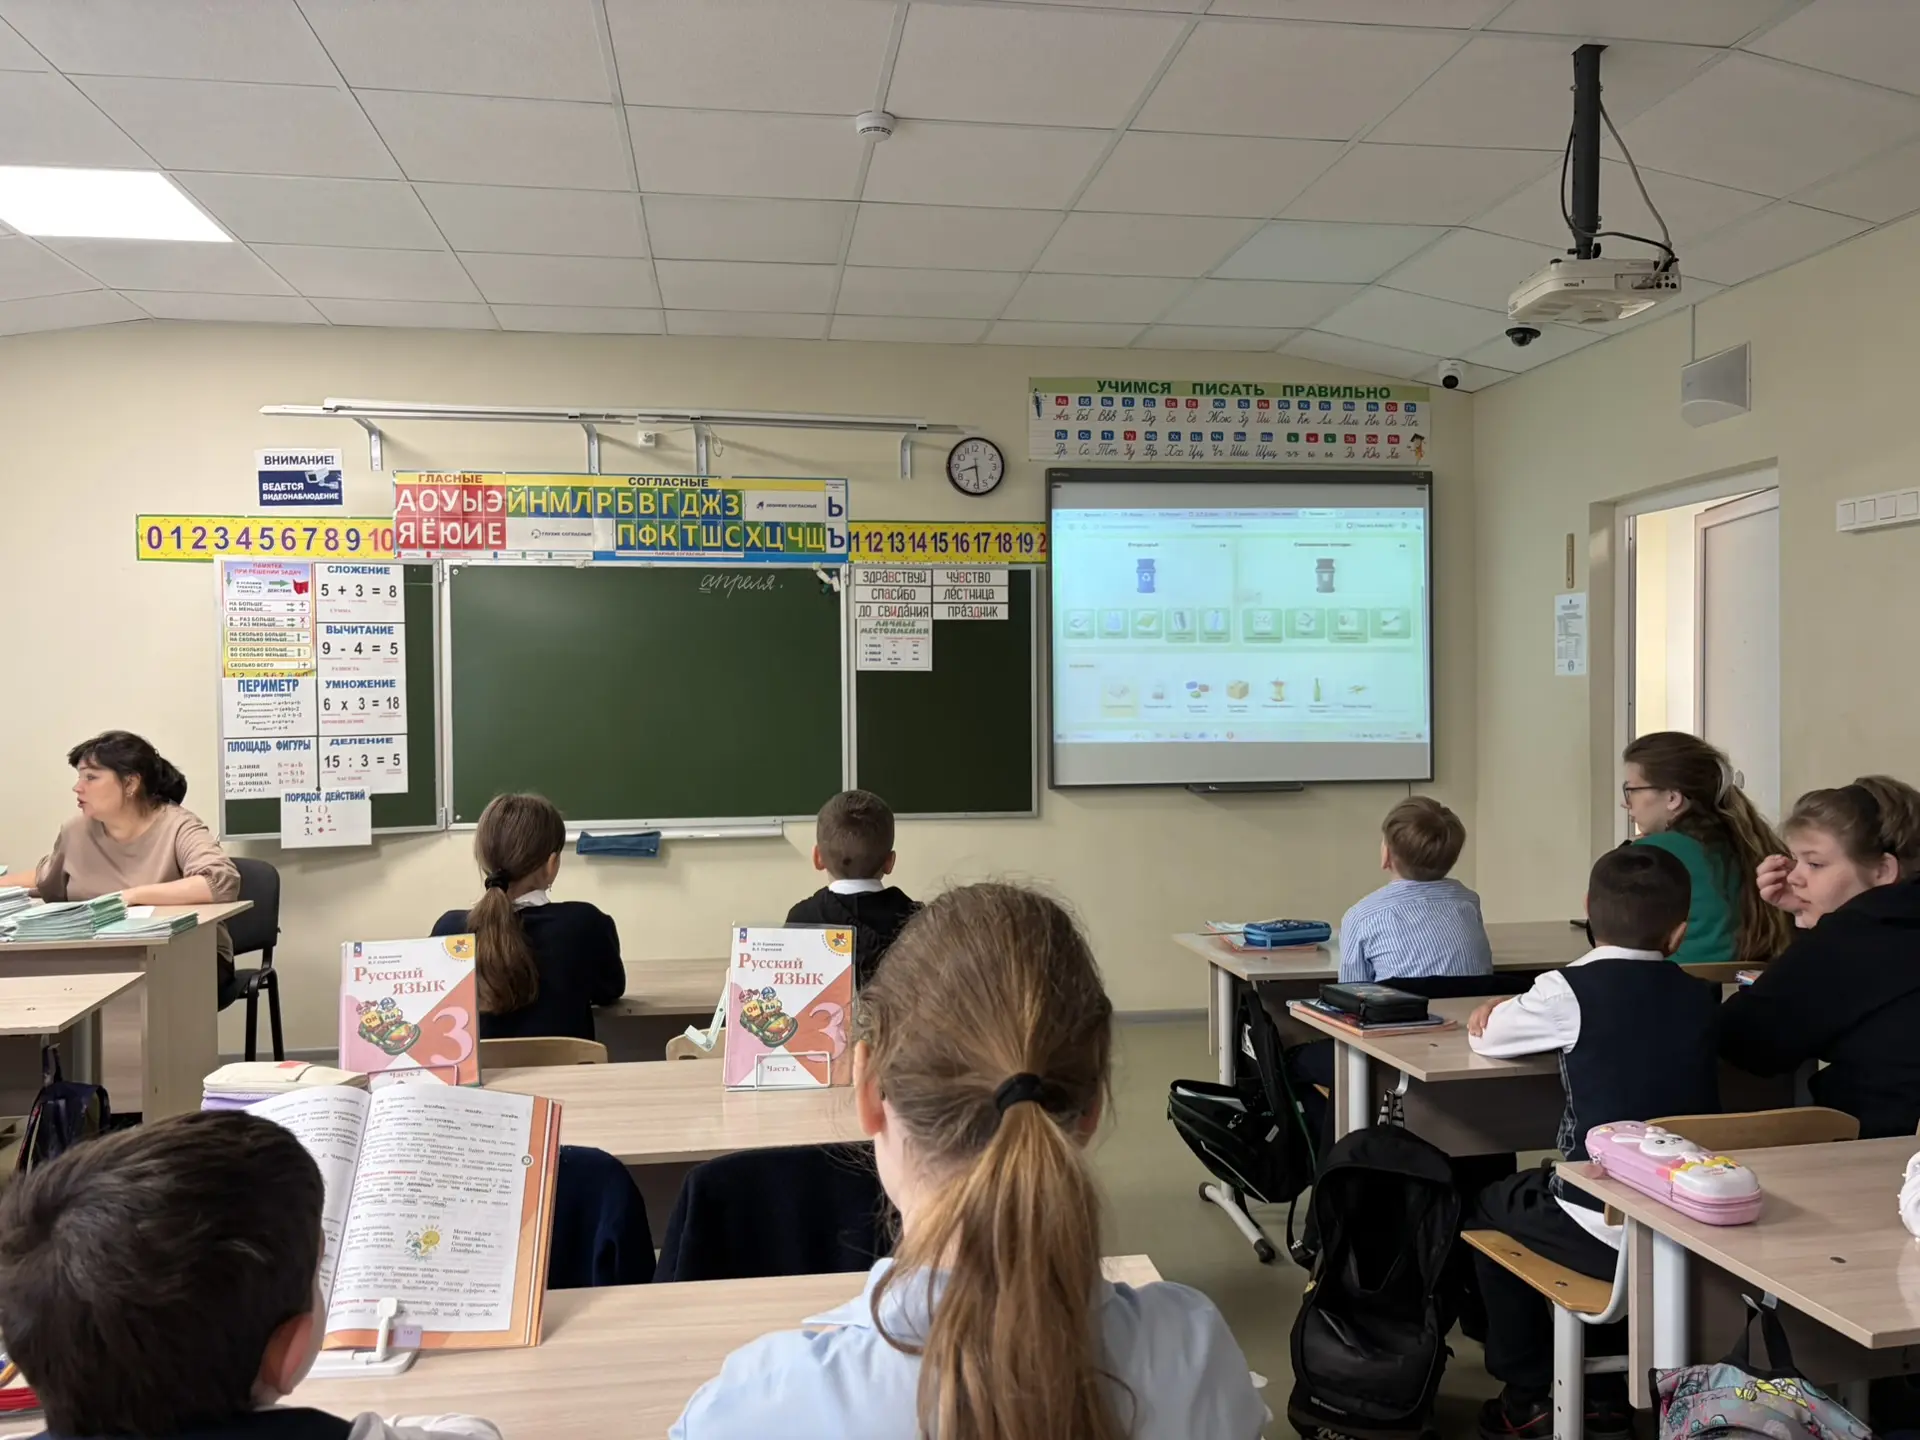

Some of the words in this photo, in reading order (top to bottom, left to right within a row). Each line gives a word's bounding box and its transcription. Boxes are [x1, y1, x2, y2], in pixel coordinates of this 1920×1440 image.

[1097, 380, 1172, 394] УЧИМСЯ
[1192, 383, 1265, 396] ПИСАТЬ
[1283, 384, 1391, 399] ПРАВИЛЬНО
[264, 456, 334, 465] ВНИМАНИЕ!
[418, 474, 483, 484] ГЛАСНЫЕ
[628, 477, 709, 488] СОГЛАСНЫЕ
[262, 483, 304, 491] ВЕДЕТСЯ
[262, 493, 339, 501] ВИДЕОНАБЛЮДЕНИЕ
[147, 526, 162, 549] 0
[171, 526, 181, 549] 1
[192, 526, 207, 549] 2
[214, 526, 229, 550] 3
[236, 527, 252, 549] 4
[260, 528, 274, 550] 5
[282, 528, 296, 550] 6
[302, 528, 317, 550] 7
[325, 528, 339, 551] 8
[346, 528, 360, 551] 9
[368, 528, 393, 551] 10
[865, 532, 883, 552] 12
[888, 532, 905, 553] 13
[909, 532, 927, 553] 14
[931, 532, 948, 553] 15
[952, 532, 970, 553] 16
[974, 532, 991, 553] 17
[995, 532, 1012, 553] 18
[1016, 532, 1033, 553] 19
[327, 566, 391, 575] СЛОЖЕНИЕ
[321, 584, 329, 596] 5
[356, 584, 363, 597] 3
[389, 585, 397, 598] 8
[326, 626, 394, 635] ВЫЧИТАНИЕ
[322, 642, 331, 655] 9
[354, 642, 363, 655] 4
[390, 642, 398, 655] 5
[238, 679, 299, 692] ПЕРИМЕТР
[326, 680, 396, 689] УМНОЖЕНИЕ
[324, 698, 331, 711] 6
[358, 697, 365, 710] 3
[386, 696, 400, 710] 18
[228, 741, 272, 754] ПЛОЩАДЬ
[276, 740, 311, 751] ФИГУРЫ
[330, 738, 394, 746] ДЕЛЕНИЕ
[324, 755, 340, 768] 15
[361, 754, 368, 767] 3
[393, 754, 401, 766] 5
[285, 793, 322, 803] ПОРЯДОК
[325, 790, 365, 802] ДЕЙСТВИЙ
[305, 816, 313, 824] 2.
[304, 828, 313, 836] 3.
[430, 1006, 474, 1066] 3
[806, 1002, 847, 1063] 3
[767, 1065, 790, 1073] Часть
